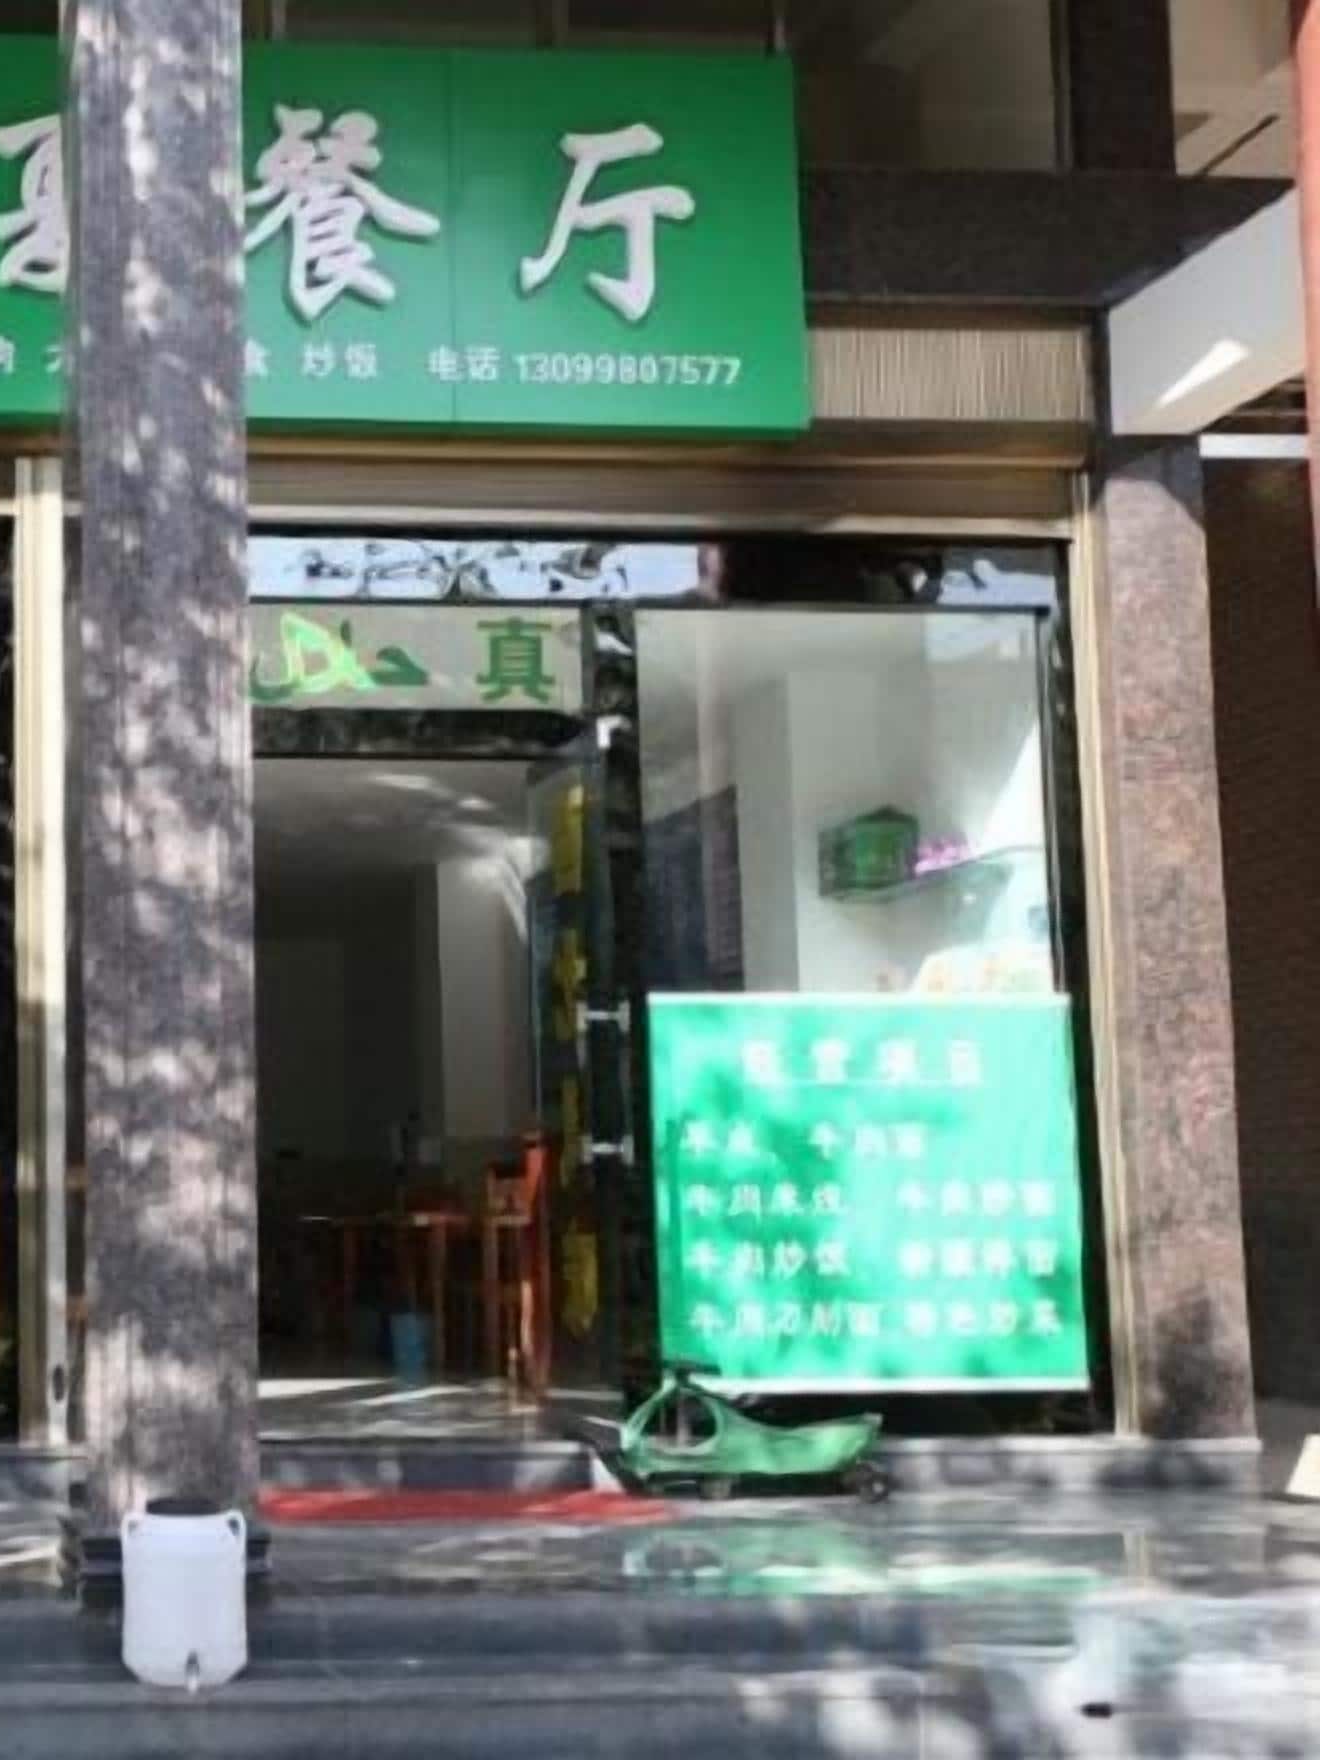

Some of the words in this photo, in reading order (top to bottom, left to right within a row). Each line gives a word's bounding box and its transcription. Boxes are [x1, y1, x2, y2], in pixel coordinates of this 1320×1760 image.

[427, 343, 500, 382] 电话
[516, 353, 742, 386] 13099807577
[476, 617, 556, 703] 真
